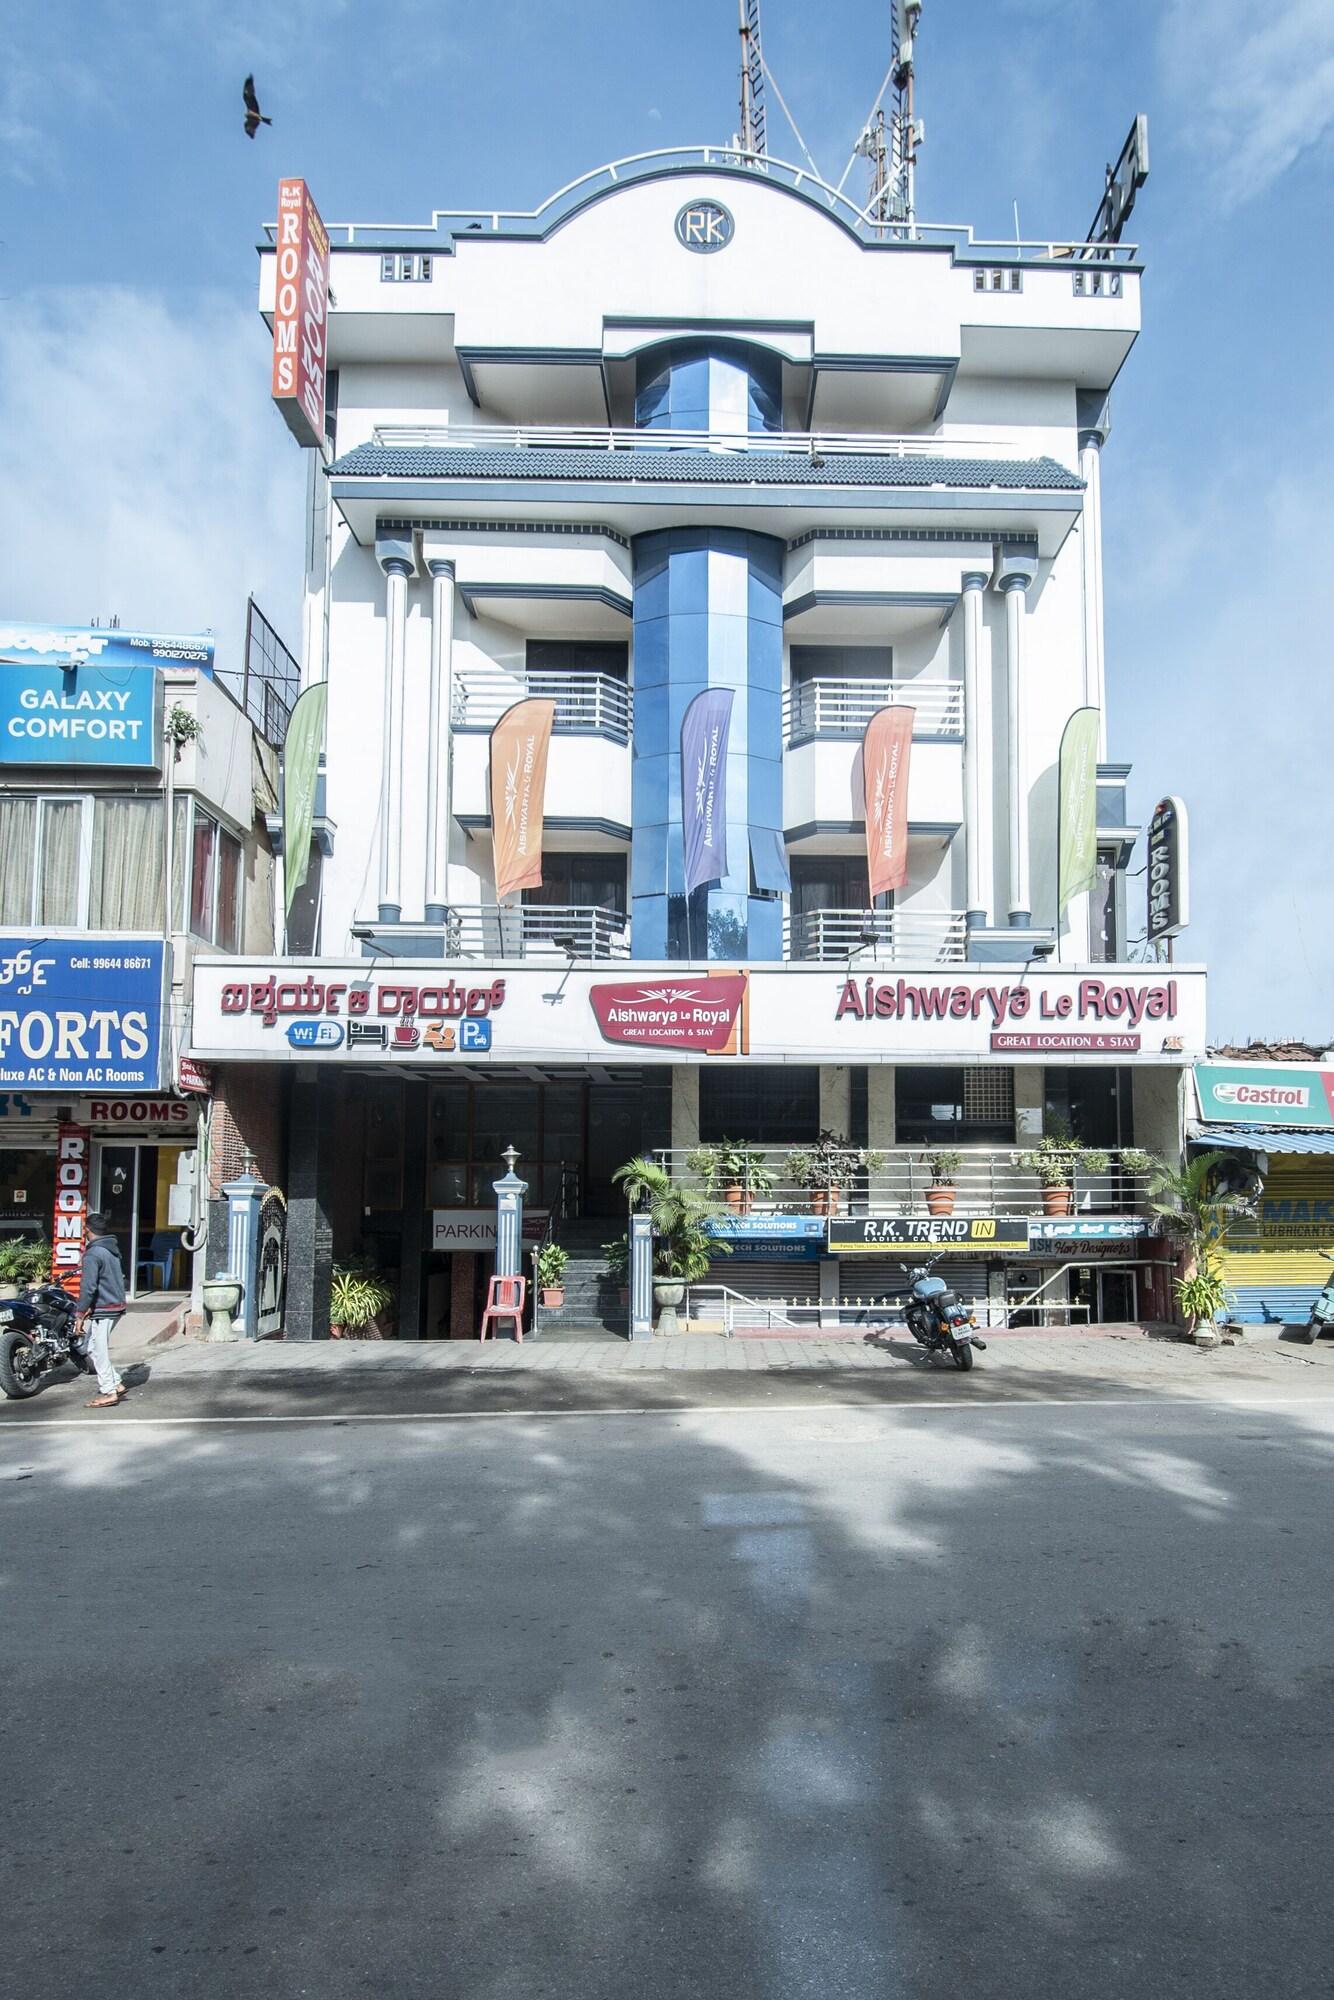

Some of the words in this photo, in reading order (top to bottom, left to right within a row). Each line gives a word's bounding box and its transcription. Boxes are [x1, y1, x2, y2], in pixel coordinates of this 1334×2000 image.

[686, 212, 725, 242] RK
[276, 213, 300, 391] ROOMS
[130, 638, 150, 648] Mob:
[20, 689, 131, 711] GALAXY
[8, 717, 143, 740] COMFORT
[1150, 846, 1170, 930] ROOMS
[70, 958, 91, 969] Cell:
[93, 958, 121, 969] 99644
[124, 958, 151, 969] 86671
[838, 977, 1031, 1026] Aishwarya
[1042, 990, 1073, 1016] Le
[1080, 980, 1177, 1026] Royal
[608, 1008, 678, 1025] Aishwarya
[681, 1012, 691, 1020] Le
[693, 1009, 730, 1025] Royal
[623, 1028, 646, 1036] GREAT
[998, 1036, 1032, 1046] GREAT
[1037, 1036, 1091, 1047] LOCATION
[1097, 1037, 1105, 1047] &
[1110, 1037, 1136, 1047] STAY
[28, 1067, 45, 1081] AC
[48, 1068, 56, 1081] &
[60, 1068, 82, 1081] Non
[86, 1068, 103, 1082] AC
[106, 1068, 145, 1082] Rooms
[1237, 1086, 1304, 1105] Castrol
[90, 1102, 189, 1121] ROOMS
[56, 1137, 84, 1265] ROOMS
[435, 1224, 497, 1238] PARKIN
[864, 1221, 900, 1236] R.K.
[905, 1220, 968, 1236] TREND
[975, 1222, 993, 1236] IN
[1262, 1224, 1334, 1236] LUBRICANTS
